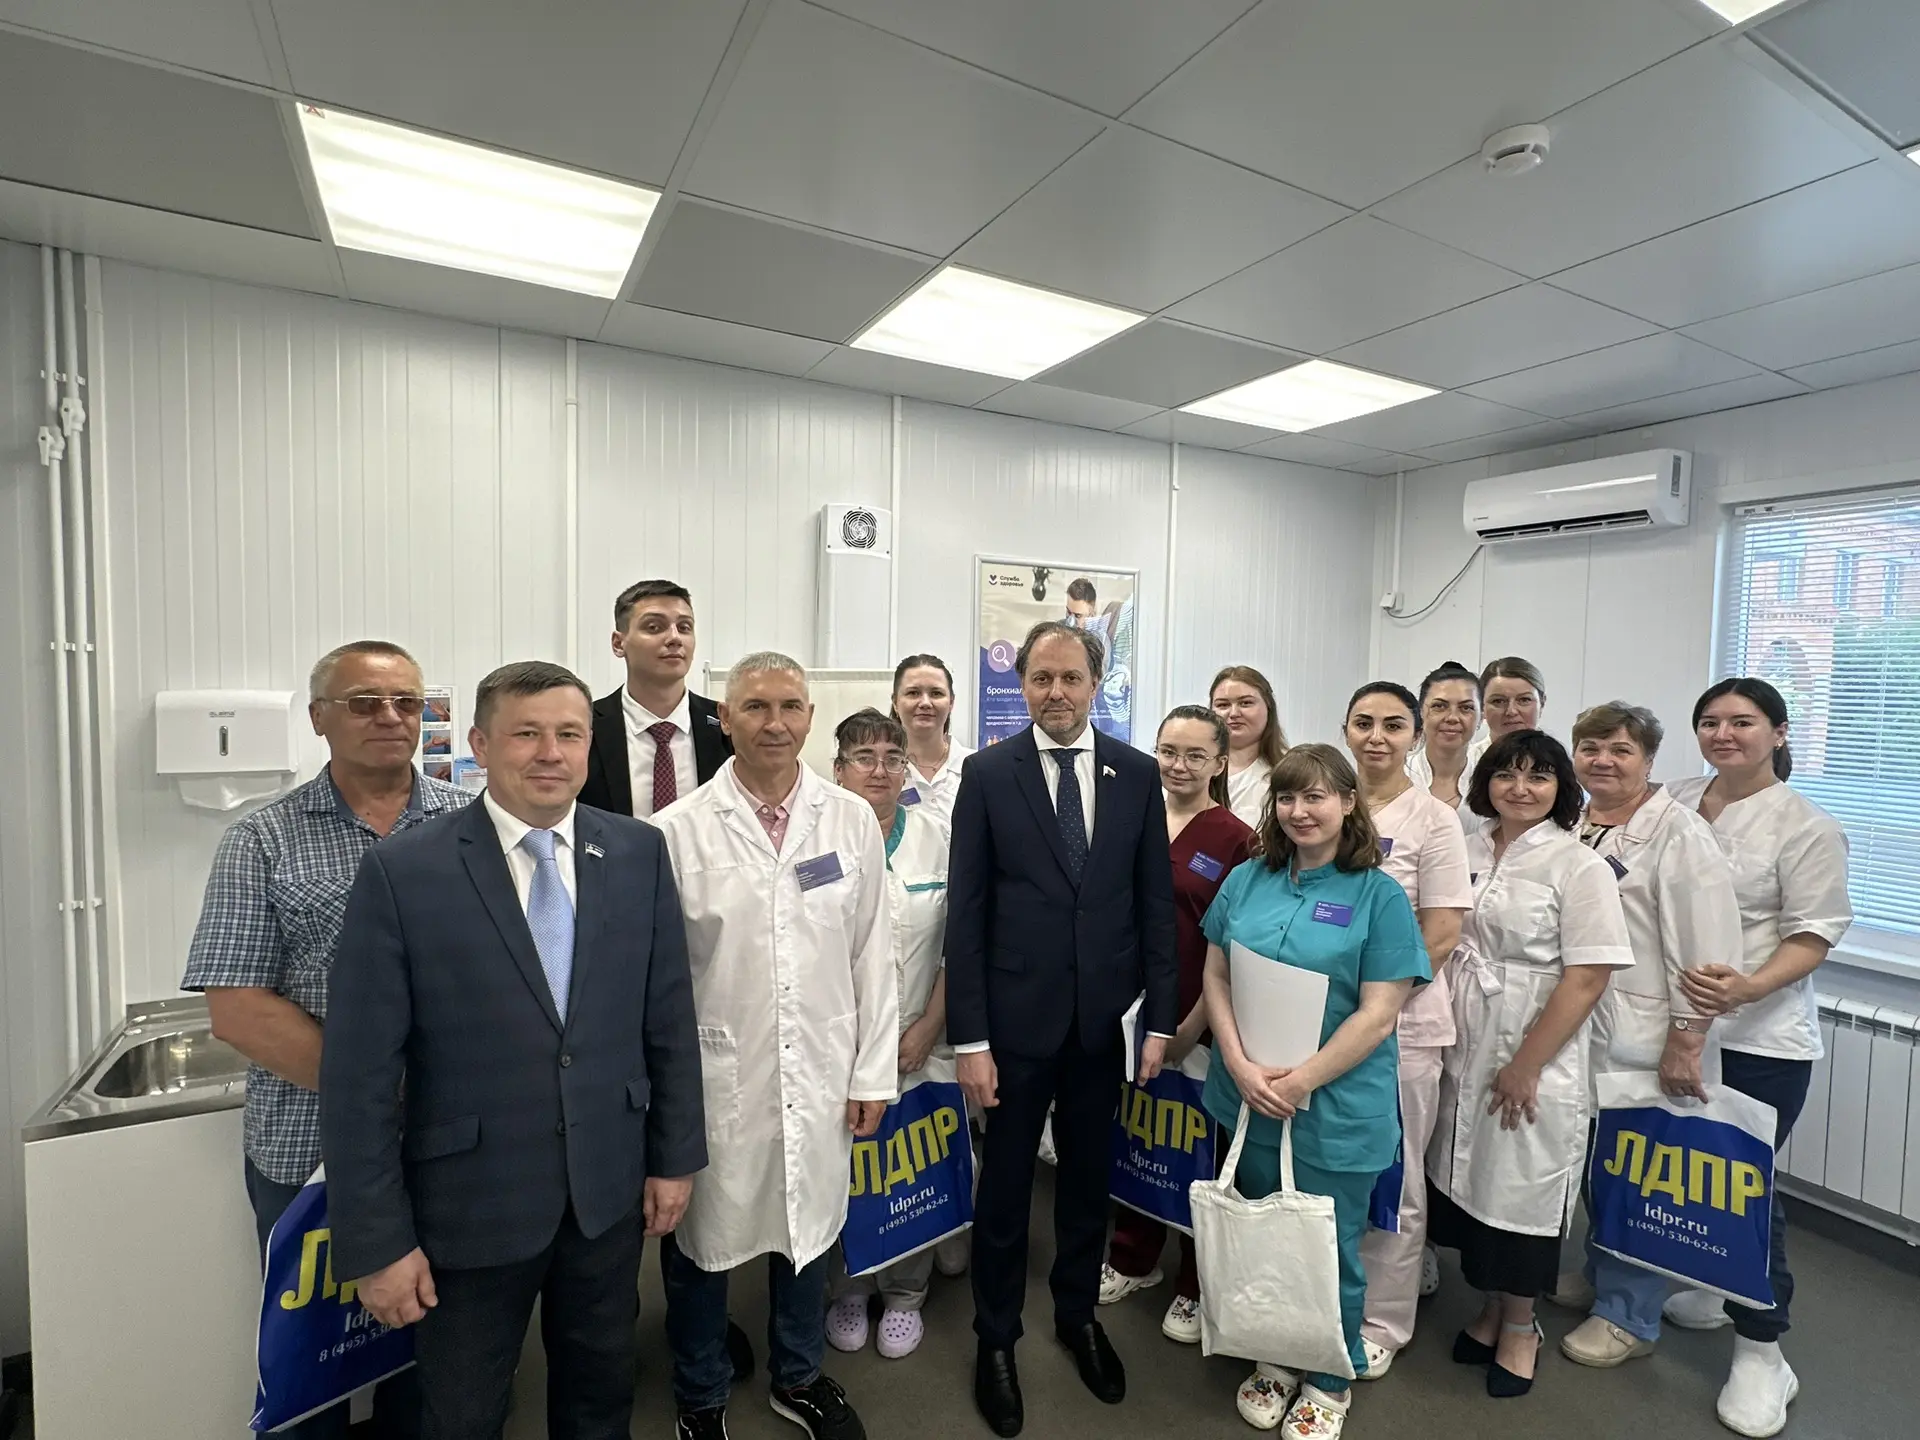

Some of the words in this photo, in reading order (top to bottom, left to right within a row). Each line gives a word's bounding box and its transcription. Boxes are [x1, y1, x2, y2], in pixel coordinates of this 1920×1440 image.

[849, 1106, 959, 1197] ЛДПР
[1140, 1172, 1180, 1192] 530-62-62
[1603, 1130, 1765, 1217] ЛДПР
[878, 1226, 885, 1235] 8
[886, 1214, 908, 1232] (495)
[909, 1193, 949, 1220] 530-62-62
[889, 1185, 936, 1215] ldpr.ru
[1627, 1218, 1635, 1228] 8
[1636, 1219, 1666, 1237] (495)
[1668, 1230, 1729, 1258] 530-62-62
[1643, 1203, 1709, 1237] ldpr.ru
[319, 1348, 329, 1362] 8
[332, 1333, 367, 1357] (495)
